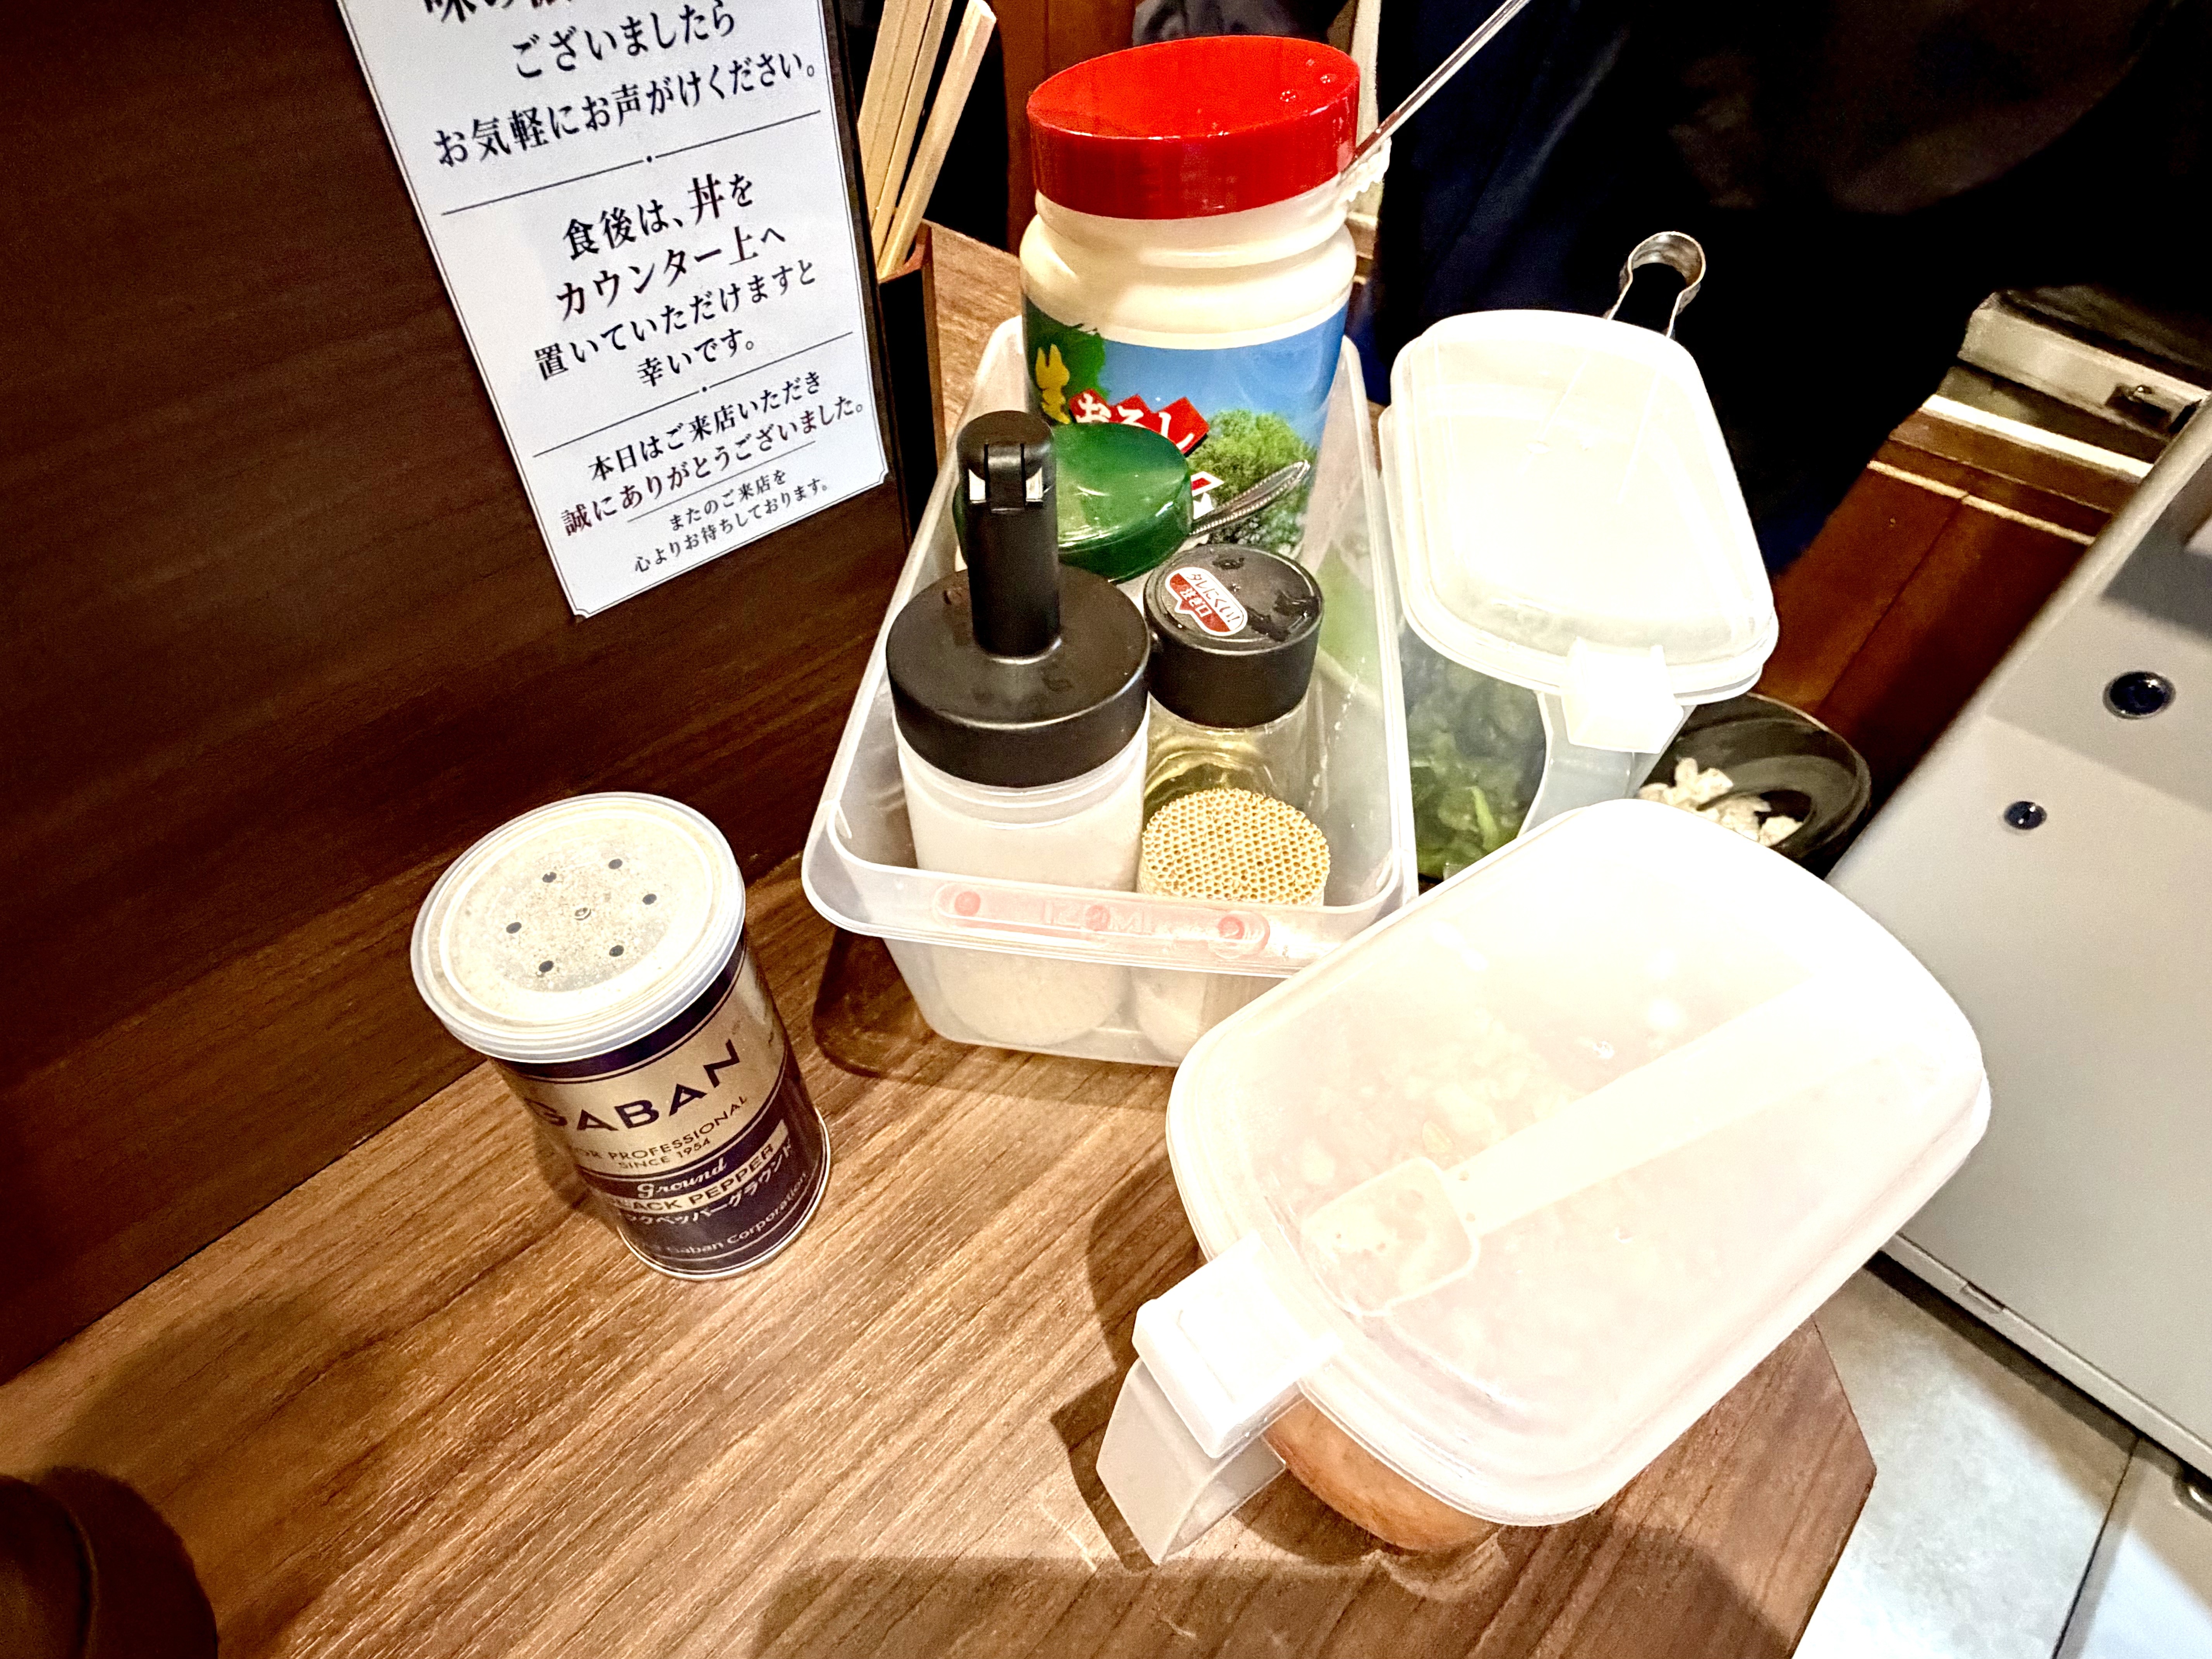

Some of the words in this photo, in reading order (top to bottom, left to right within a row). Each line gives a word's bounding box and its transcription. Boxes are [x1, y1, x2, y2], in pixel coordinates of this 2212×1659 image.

[512, 1, 735, 78] ございましたら
[433, 53, 815, 167] お気軽にお声がけください。
[563, 173, 752, 261] 食後は、丼を
[556, 227, 785, 321] カウンター上へ
[534, 259, 816, 381] 置いていただけますと
[637, 328, 754, 386] 幸いです。
[560, 395, 863, 536] 誠にありがとうございました。
[588, 371, 820, 482] 本日はご来店いただき
[634, 478, 827, 573] 心よりお待ちしております。
[670, 469, 786, 531] またのご来店を
[524, 1039, 741, 1132] SABAN
[608, 1094, 747, 1160] PROFESSIONAL
[618, 1156, 670, 1169] SINCE
[676, 1137, 711, 1158] 1954
[637, 1157, 727, 1199] Ground
[688, 1143, 773, 1206] PEPPER
[727, 1172, 807, 1244] Corporation
